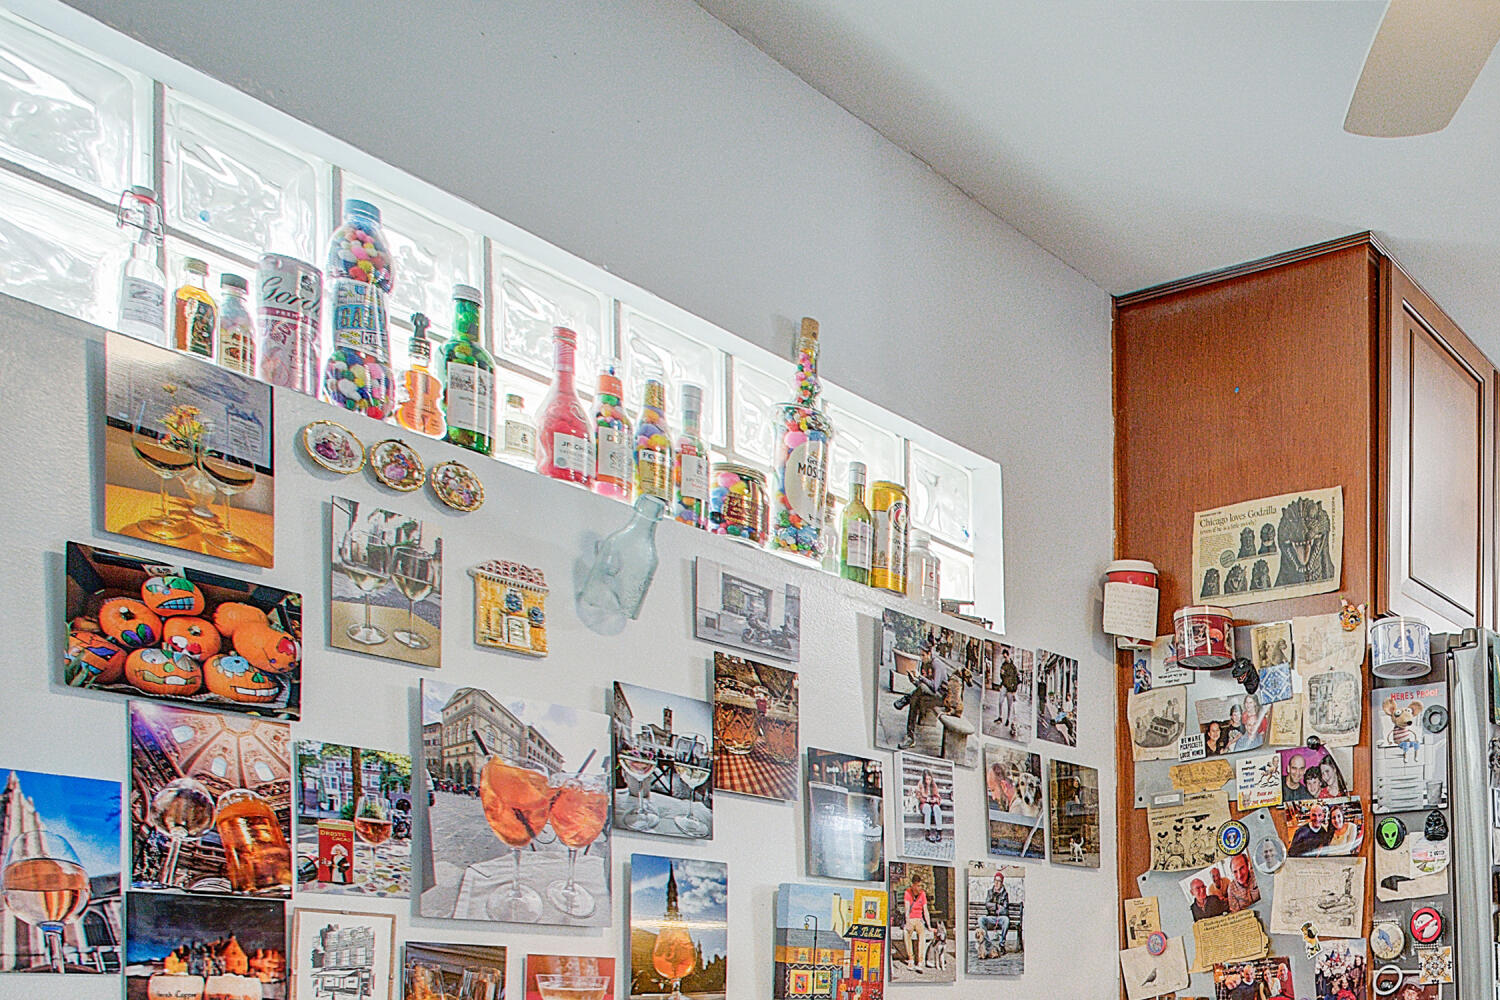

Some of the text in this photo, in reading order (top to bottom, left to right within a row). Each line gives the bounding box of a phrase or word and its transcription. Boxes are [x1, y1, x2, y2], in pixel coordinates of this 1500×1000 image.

[1200, 517, 1228, 528] Chicago
[1229, 513, 1246, 522] loves
[1247, 506, 1277, 518] Godzilla
[1390, 691, 1414, 701] HERE'S
